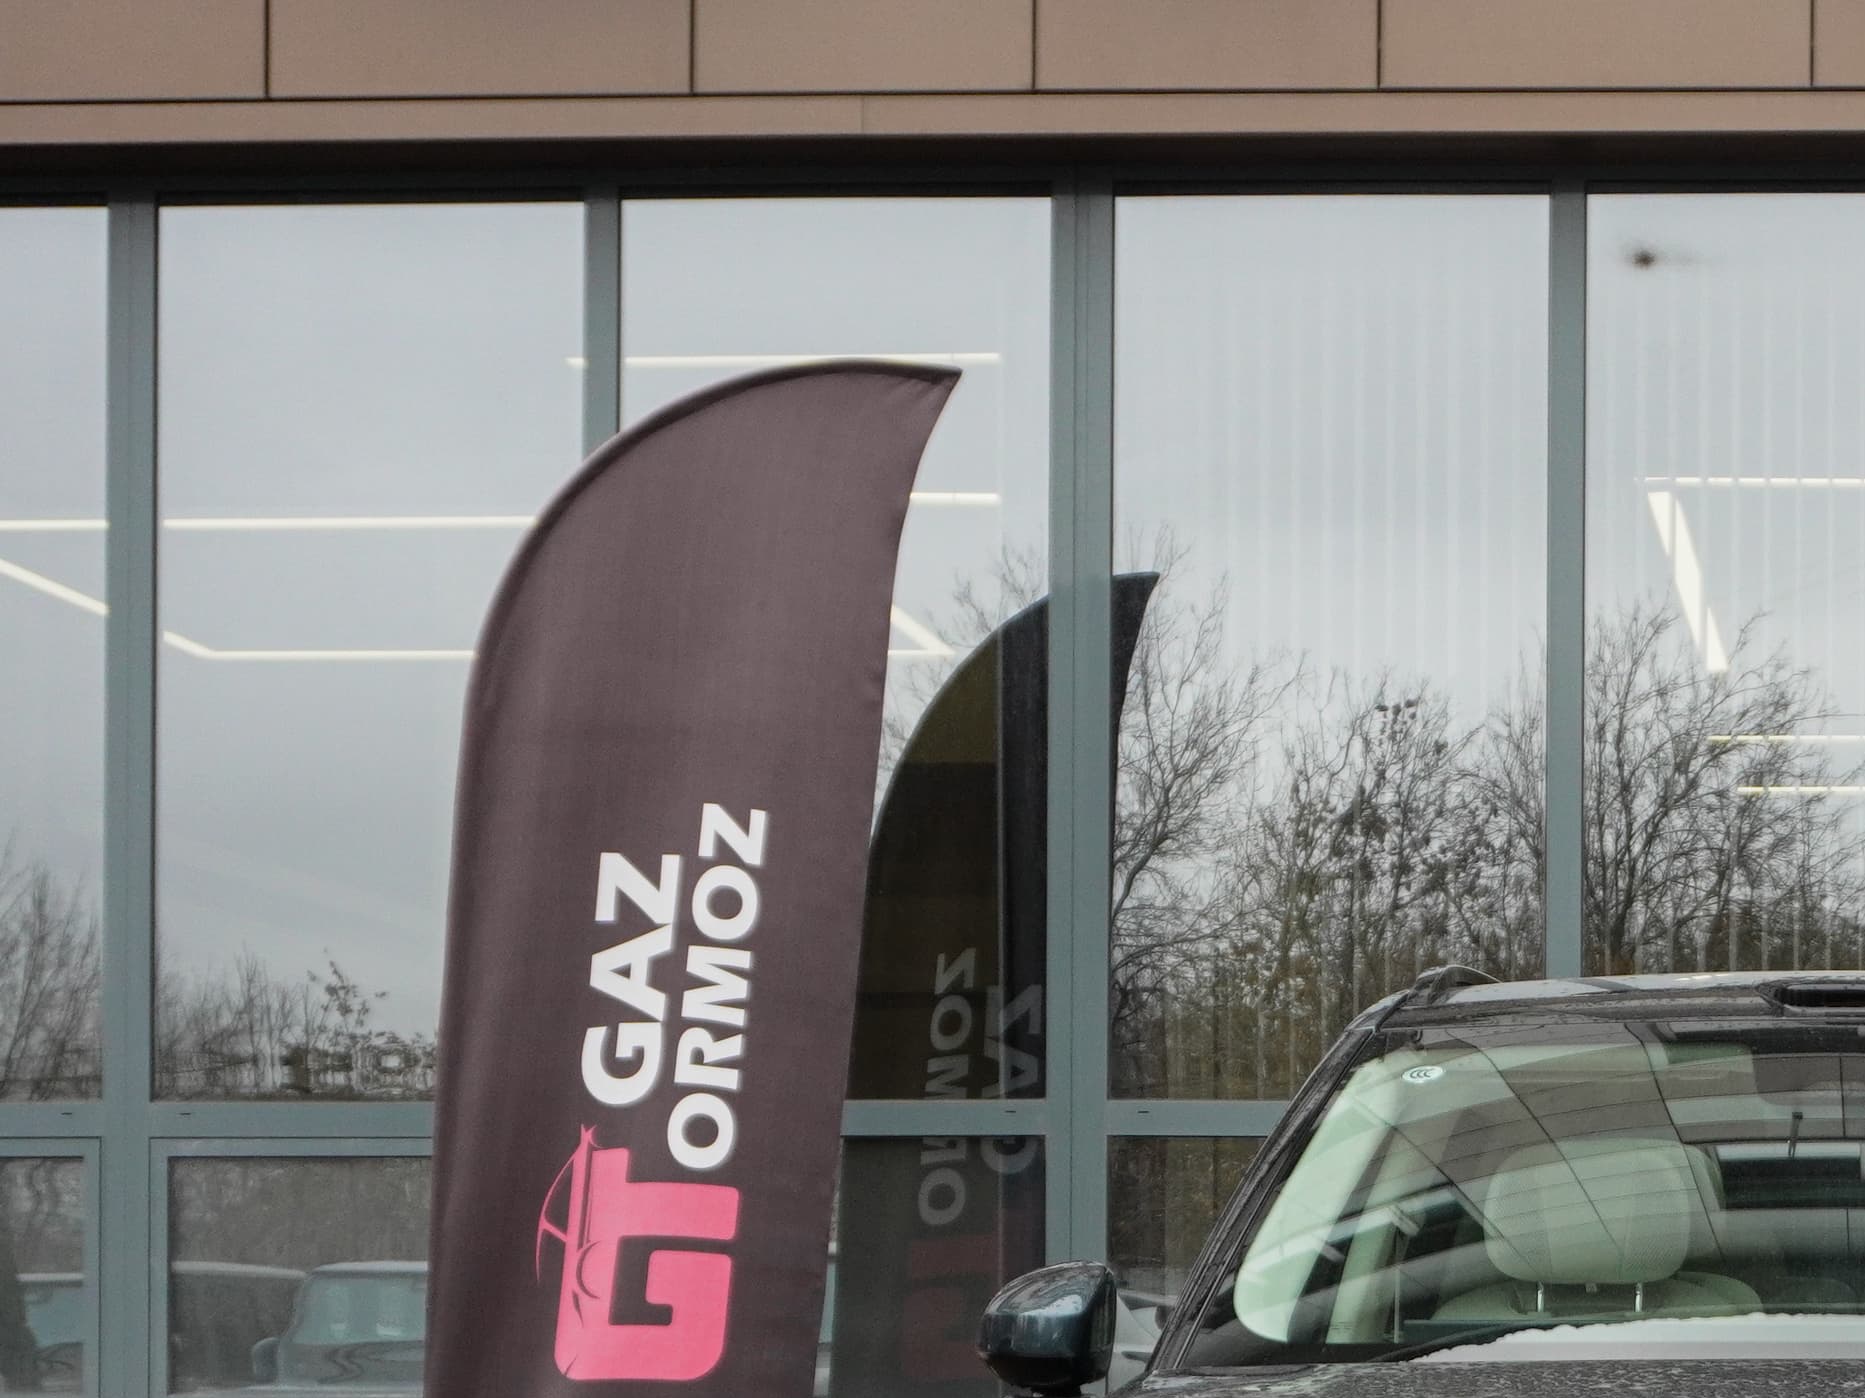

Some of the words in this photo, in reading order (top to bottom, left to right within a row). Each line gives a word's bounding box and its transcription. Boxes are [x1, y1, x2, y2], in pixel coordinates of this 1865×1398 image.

[581, 852, 682, 1105] GAZ
[667, 802, 767, 1169] ORMOZ
[537, 1126, 741, 1382] GT
